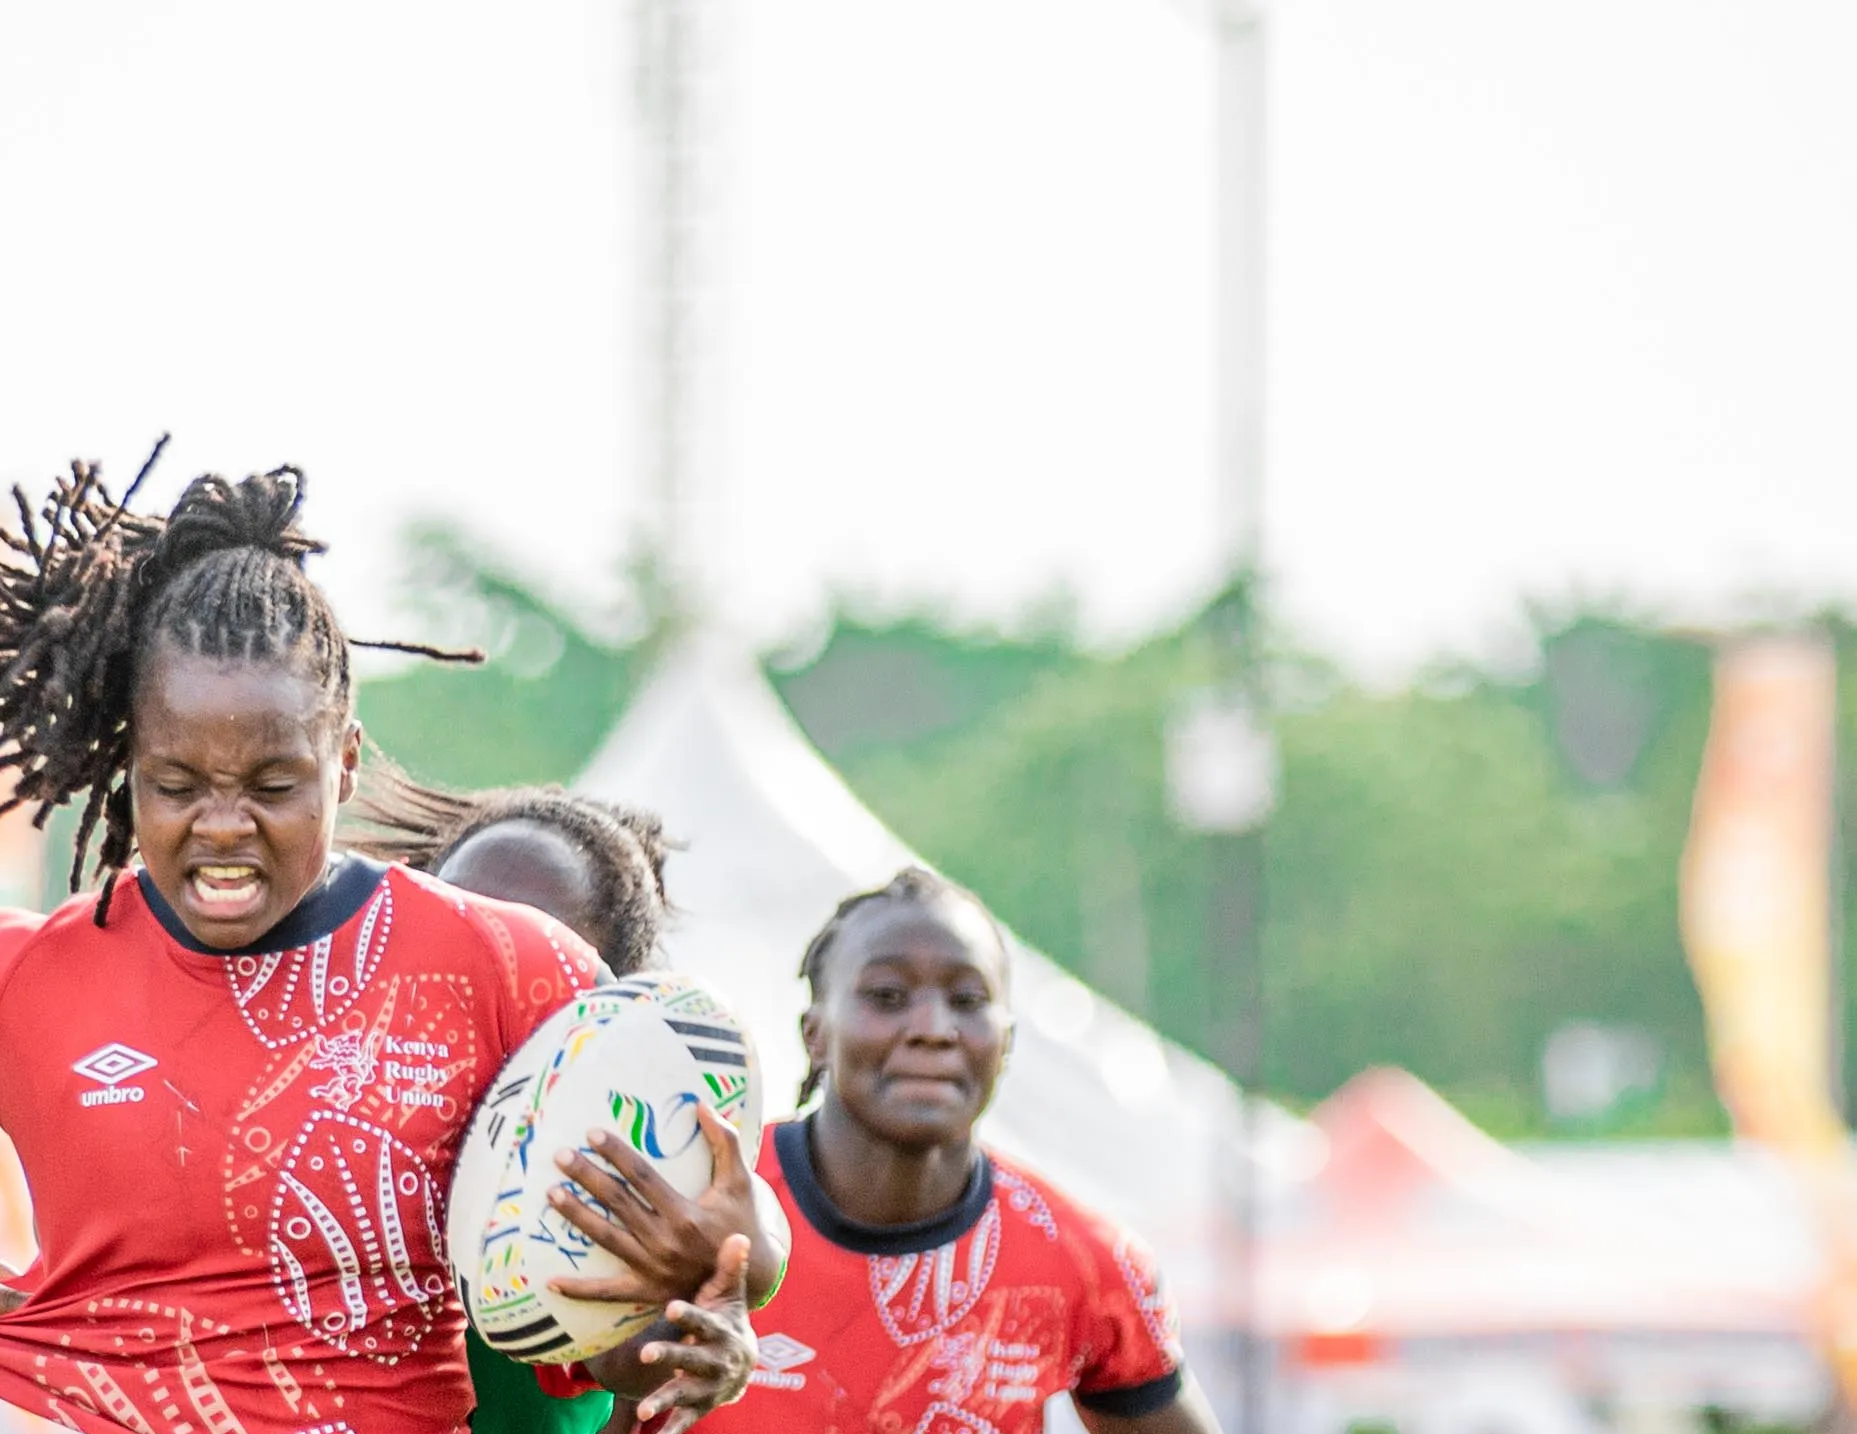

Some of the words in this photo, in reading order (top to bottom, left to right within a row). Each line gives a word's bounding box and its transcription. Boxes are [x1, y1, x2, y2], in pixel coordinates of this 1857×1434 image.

[385, 1035, 450, 1060] Kenya
[384, 1061, 449, 1087] Rugby
[79, 1085, 145, 1108] umbro
[385, 1085, 445, 1108] Union
